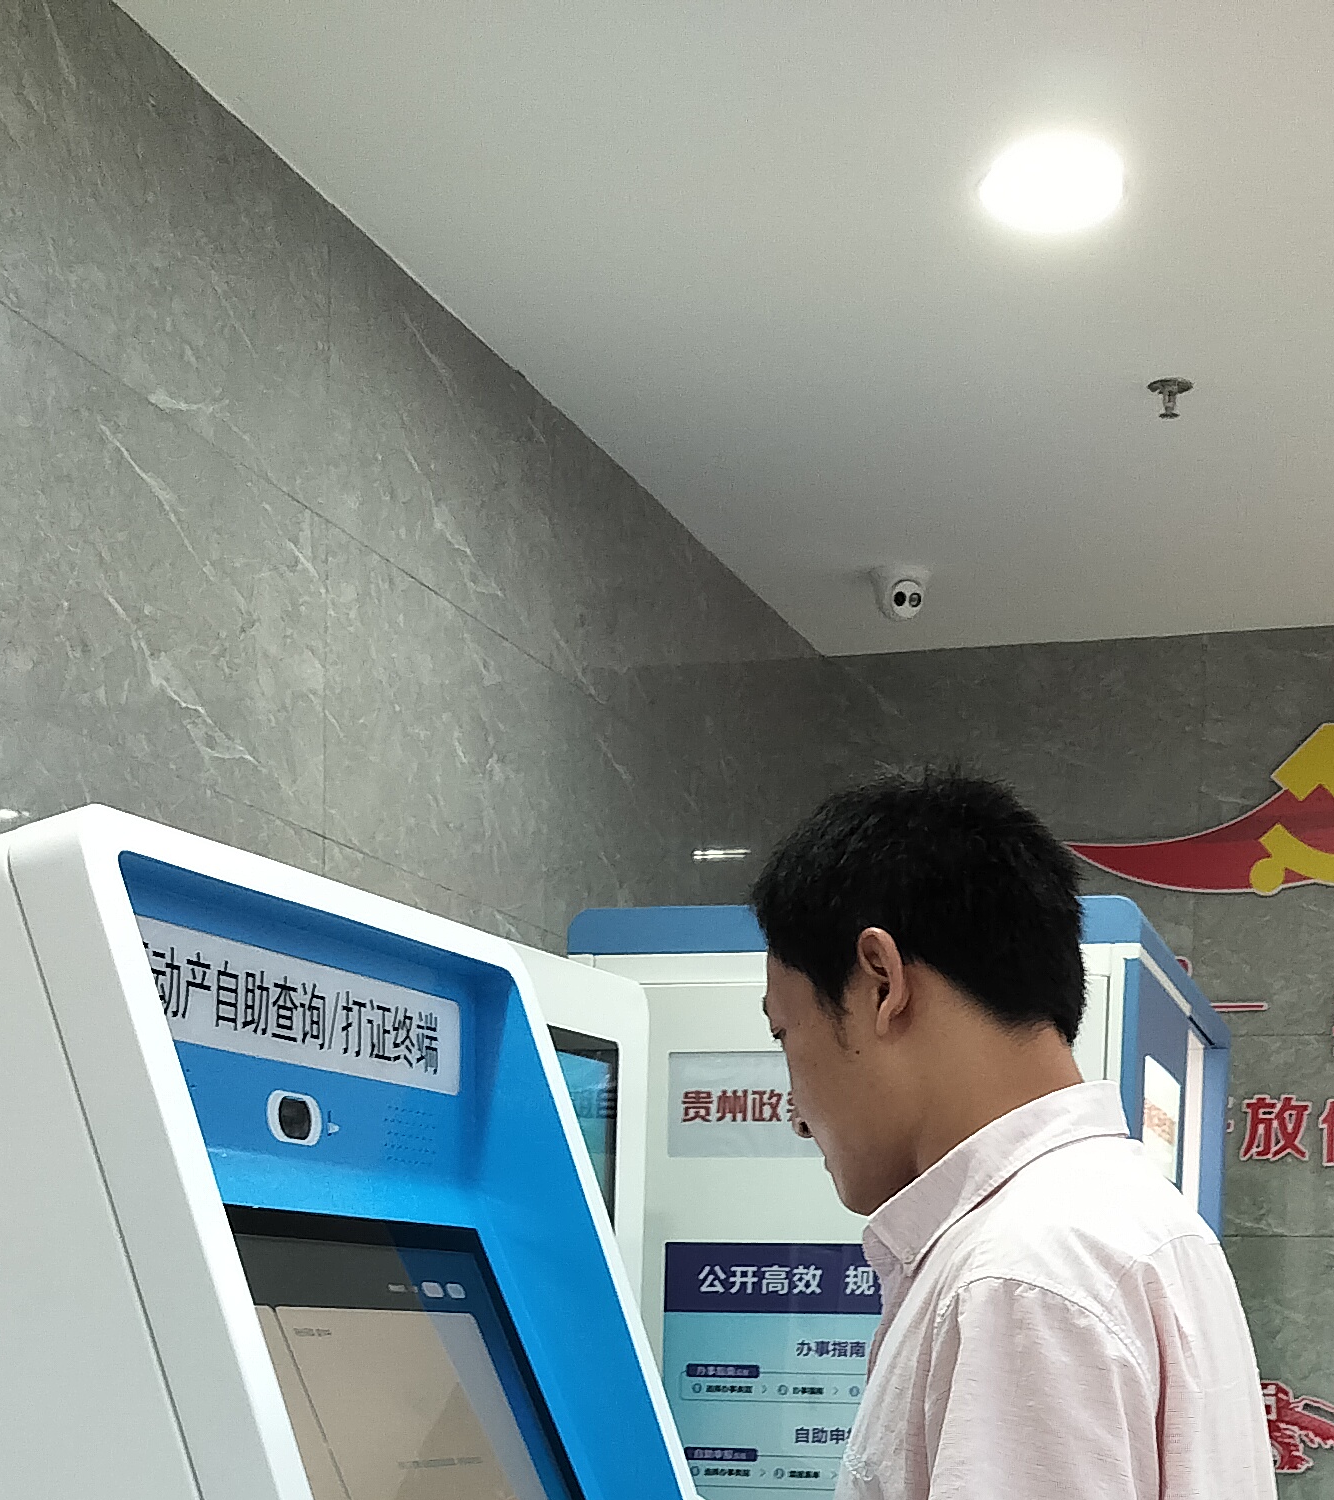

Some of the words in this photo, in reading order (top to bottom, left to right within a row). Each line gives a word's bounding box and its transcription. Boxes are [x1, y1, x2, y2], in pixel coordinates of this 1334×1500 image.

[143, 939, 440, 1076] 动产自助查询/打证终端
[680, 1088, 795, 1124] 贵州政
[696, 1264, 824, 1297] 公开高效
[843, 1265, 883, 1297] 规
[795, 1340, 866, 1359] 办事指南
